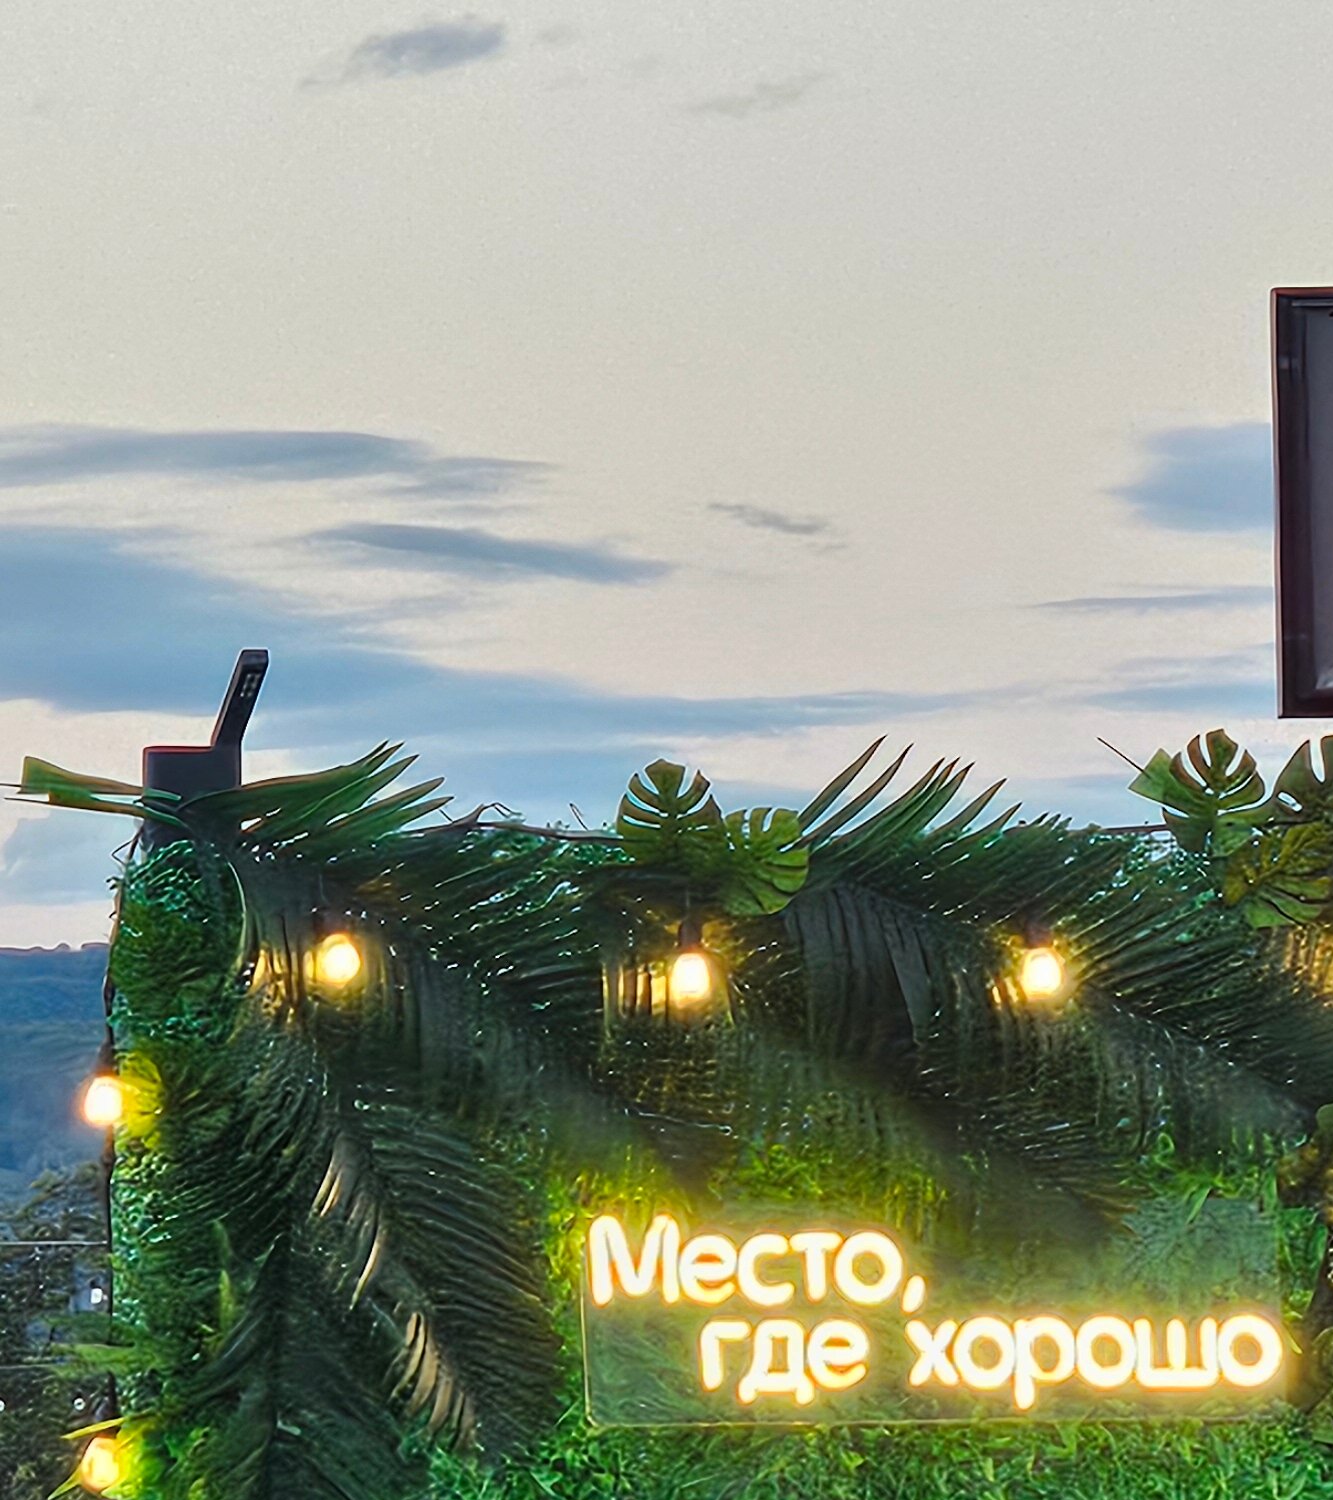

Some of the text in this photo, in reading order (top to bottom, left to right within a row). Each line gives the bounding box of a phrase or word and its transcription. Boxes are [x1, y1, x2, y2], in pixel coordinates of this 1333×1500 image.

[587, 1214, 927, 1312] Место,
[699, 1314, 1284, 1410] где хорошо
